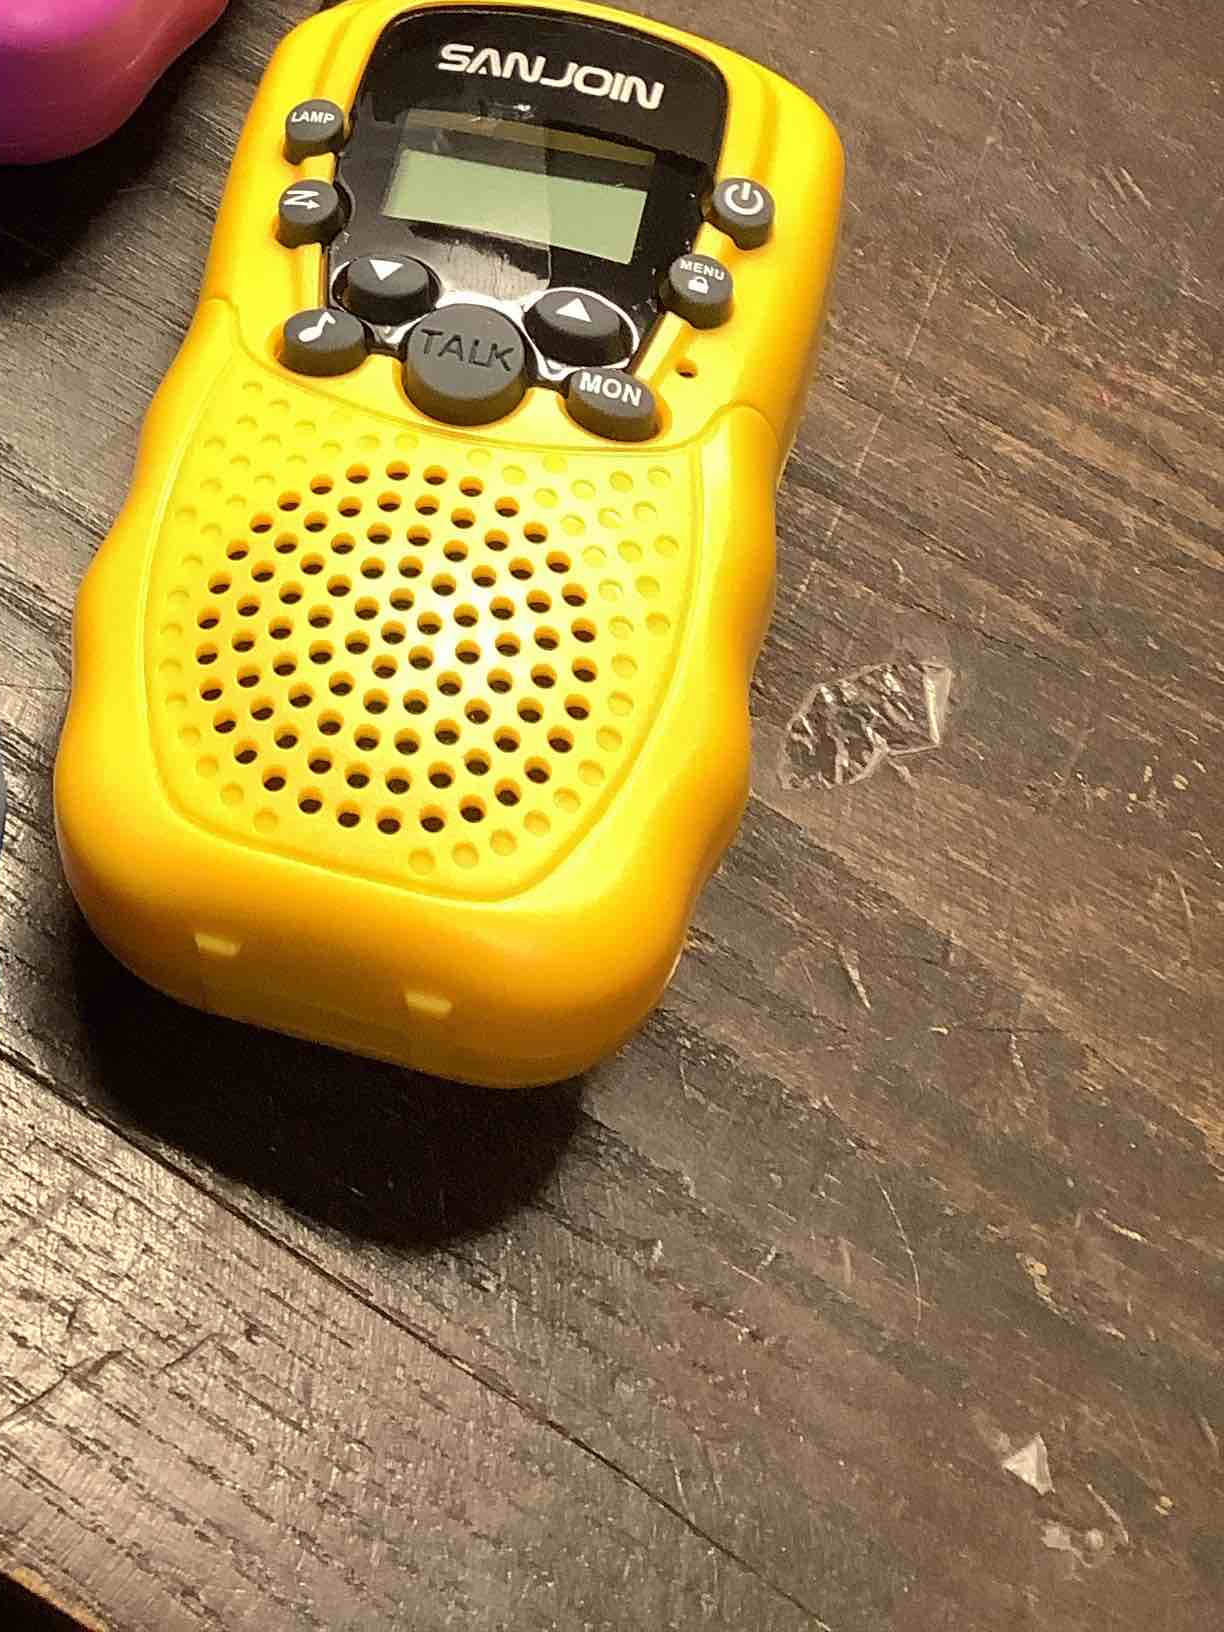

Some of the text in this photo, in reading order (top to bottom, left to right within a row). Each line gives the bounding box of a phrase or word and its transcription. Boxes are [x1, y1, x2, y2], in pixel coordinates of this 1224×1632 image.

[437, 43, 665, 111] SANJOIN
[291, 109, 336, 126] LAMP
[679, 258, 725, 282] MENU
[420, 328, 516, 373] TALK
[578, 370, 644, 408] MON
